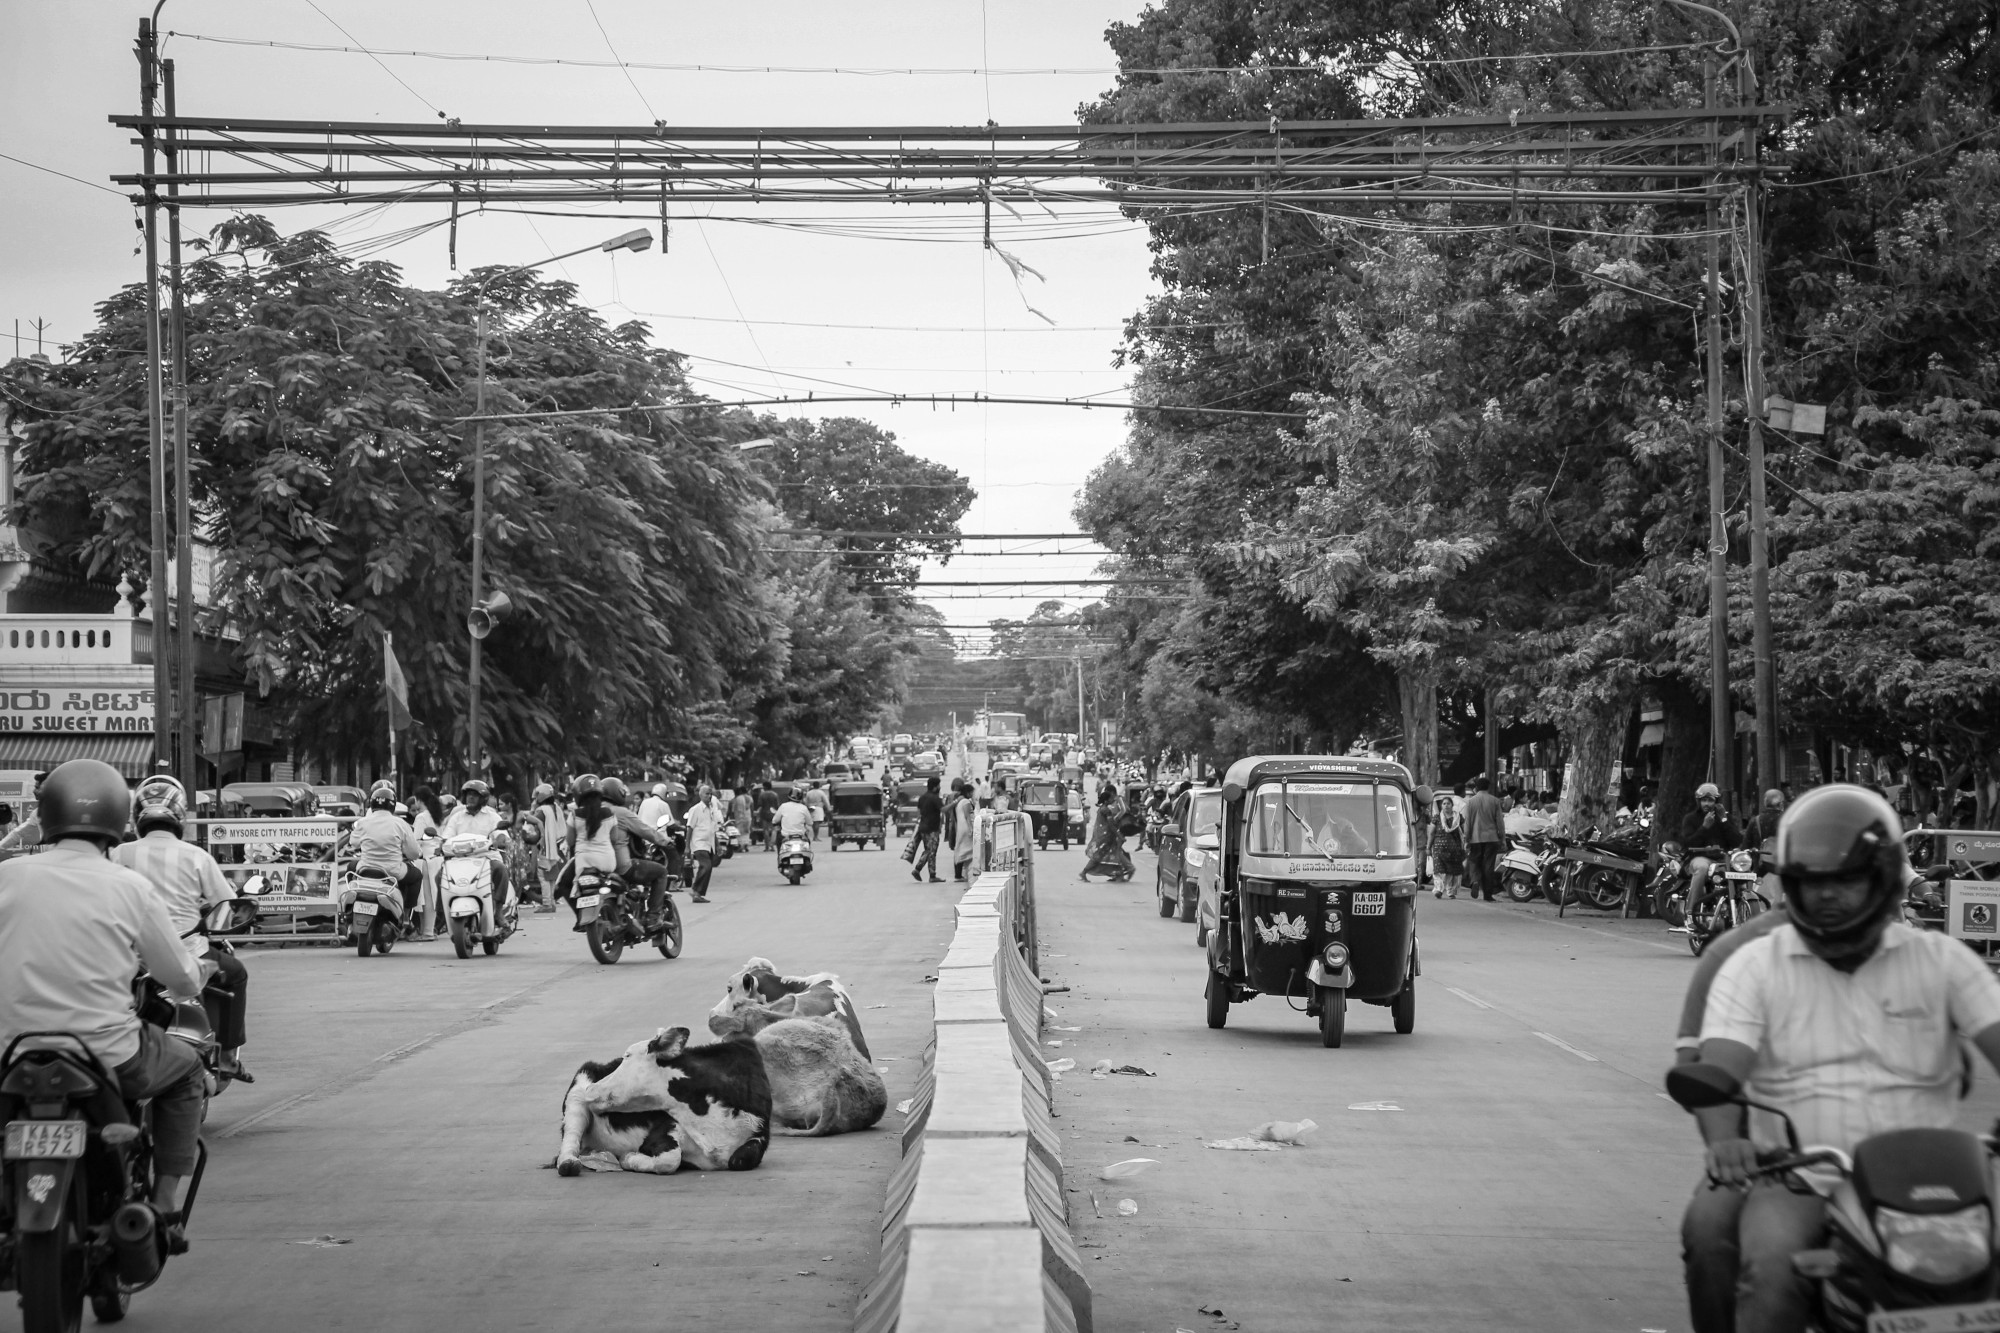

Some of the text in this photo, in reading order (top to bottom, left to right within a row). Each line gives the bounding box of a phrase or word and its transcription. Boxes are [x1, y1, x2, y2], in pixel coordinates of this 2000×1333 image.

[32, 716, 98, 731] SWEET
[229, 828, 336, 838] MYSORE CITY TRAFFIC POLICE
[1354, 904, 1384, 914] 6607
